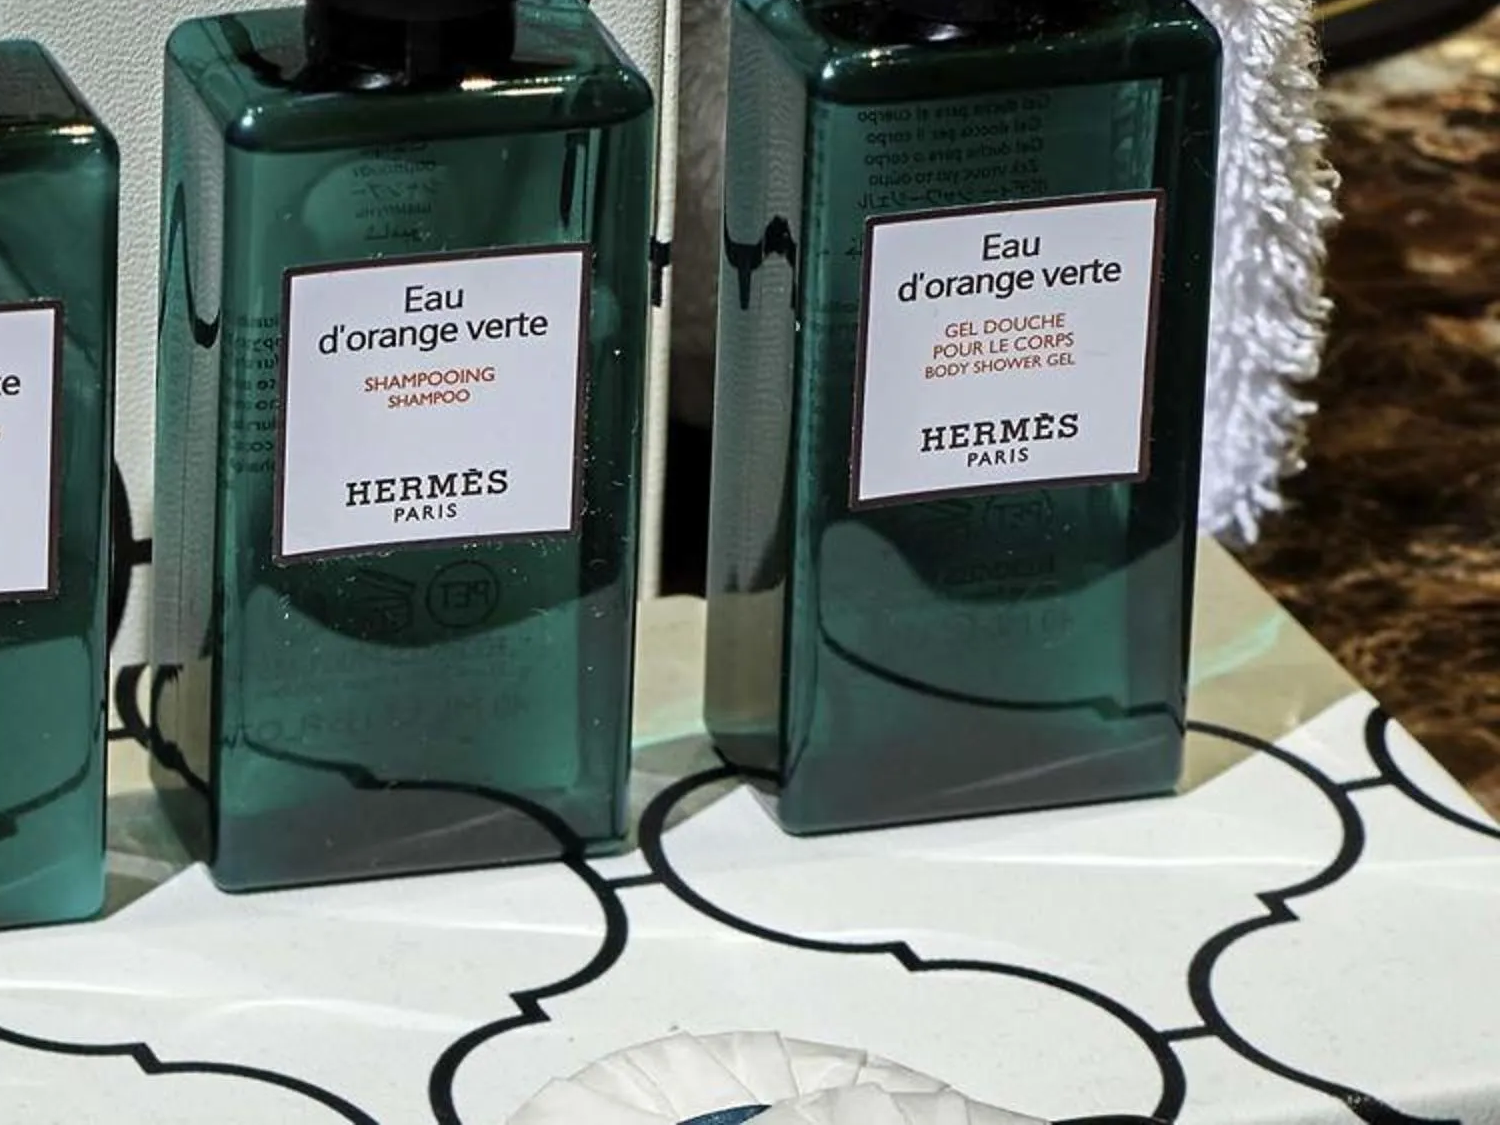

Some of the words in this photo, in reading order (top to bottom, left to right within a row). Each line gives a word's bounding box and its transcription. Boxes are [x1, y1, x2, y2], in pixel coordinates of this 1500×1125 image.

[982, 233, 1041, 262] Eau
[897, 269, 1035, 302] d'orange
[1042, 259, 1122, 287] verte
[404, 285, 464, 313] Eau
[318, 323, 459, 355] d'orange
[465, 312, 549, 341] verte
[944, 321, 979, 339] GEL
[983, 313, 1066, 334] DOUCHE
[933, 341, 984, 360] POUR
[989, 338, 1009, 354] LE
[1014, 332, 1075, 352] CORPS
[363, 366, 496, 392] SHAMPOOING
[924, 361, 970, 379] BODY
[973, 355, 1042, 374] SHOWER
[1047, 352, 1076, 367] GEL
[387, 388, 471, 409] SHAMPOO
[920, 412, 1079, 453] HERMÈS
[967, 447, 1029, 468] PARIS
[345, 468, 509, 507] HERMÈS
[393, 503, 458, 523] PARIS
